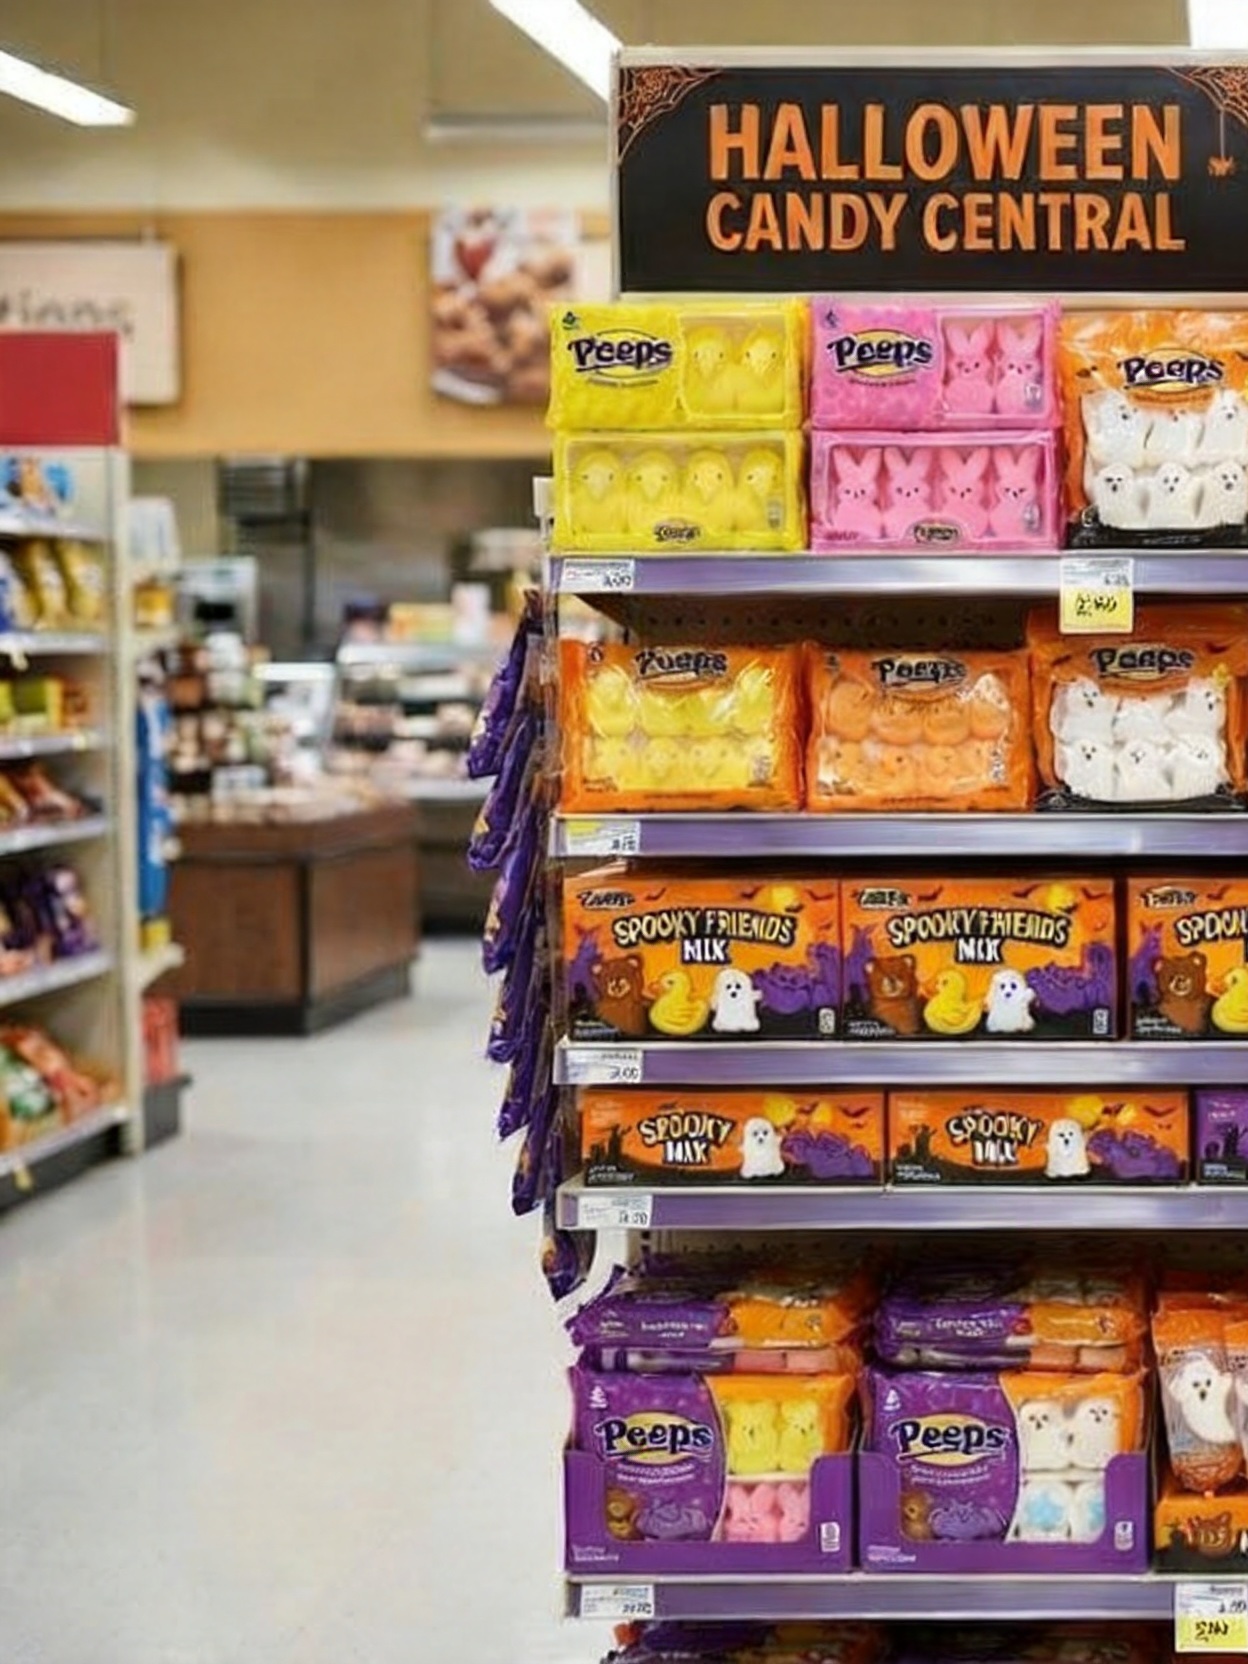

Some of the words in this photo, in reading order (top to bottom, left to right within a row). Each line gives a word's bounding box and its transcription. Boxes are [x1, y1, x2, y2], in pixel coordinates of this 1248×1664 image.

[709, 103, 1181, 181] HALLOWEEN
[706, 192, 909, 252] CANDY
[923, 192, 1185, 252] CENTRAL
[567, 336, 673, 371] Peeps
[827, 336, 934, 371] Peeps
[613, 909, 700, 944] SPOOKY
[595, 1420, 714, 1457] Peeps
[890, 1421, 1006, 1459] Peeps
